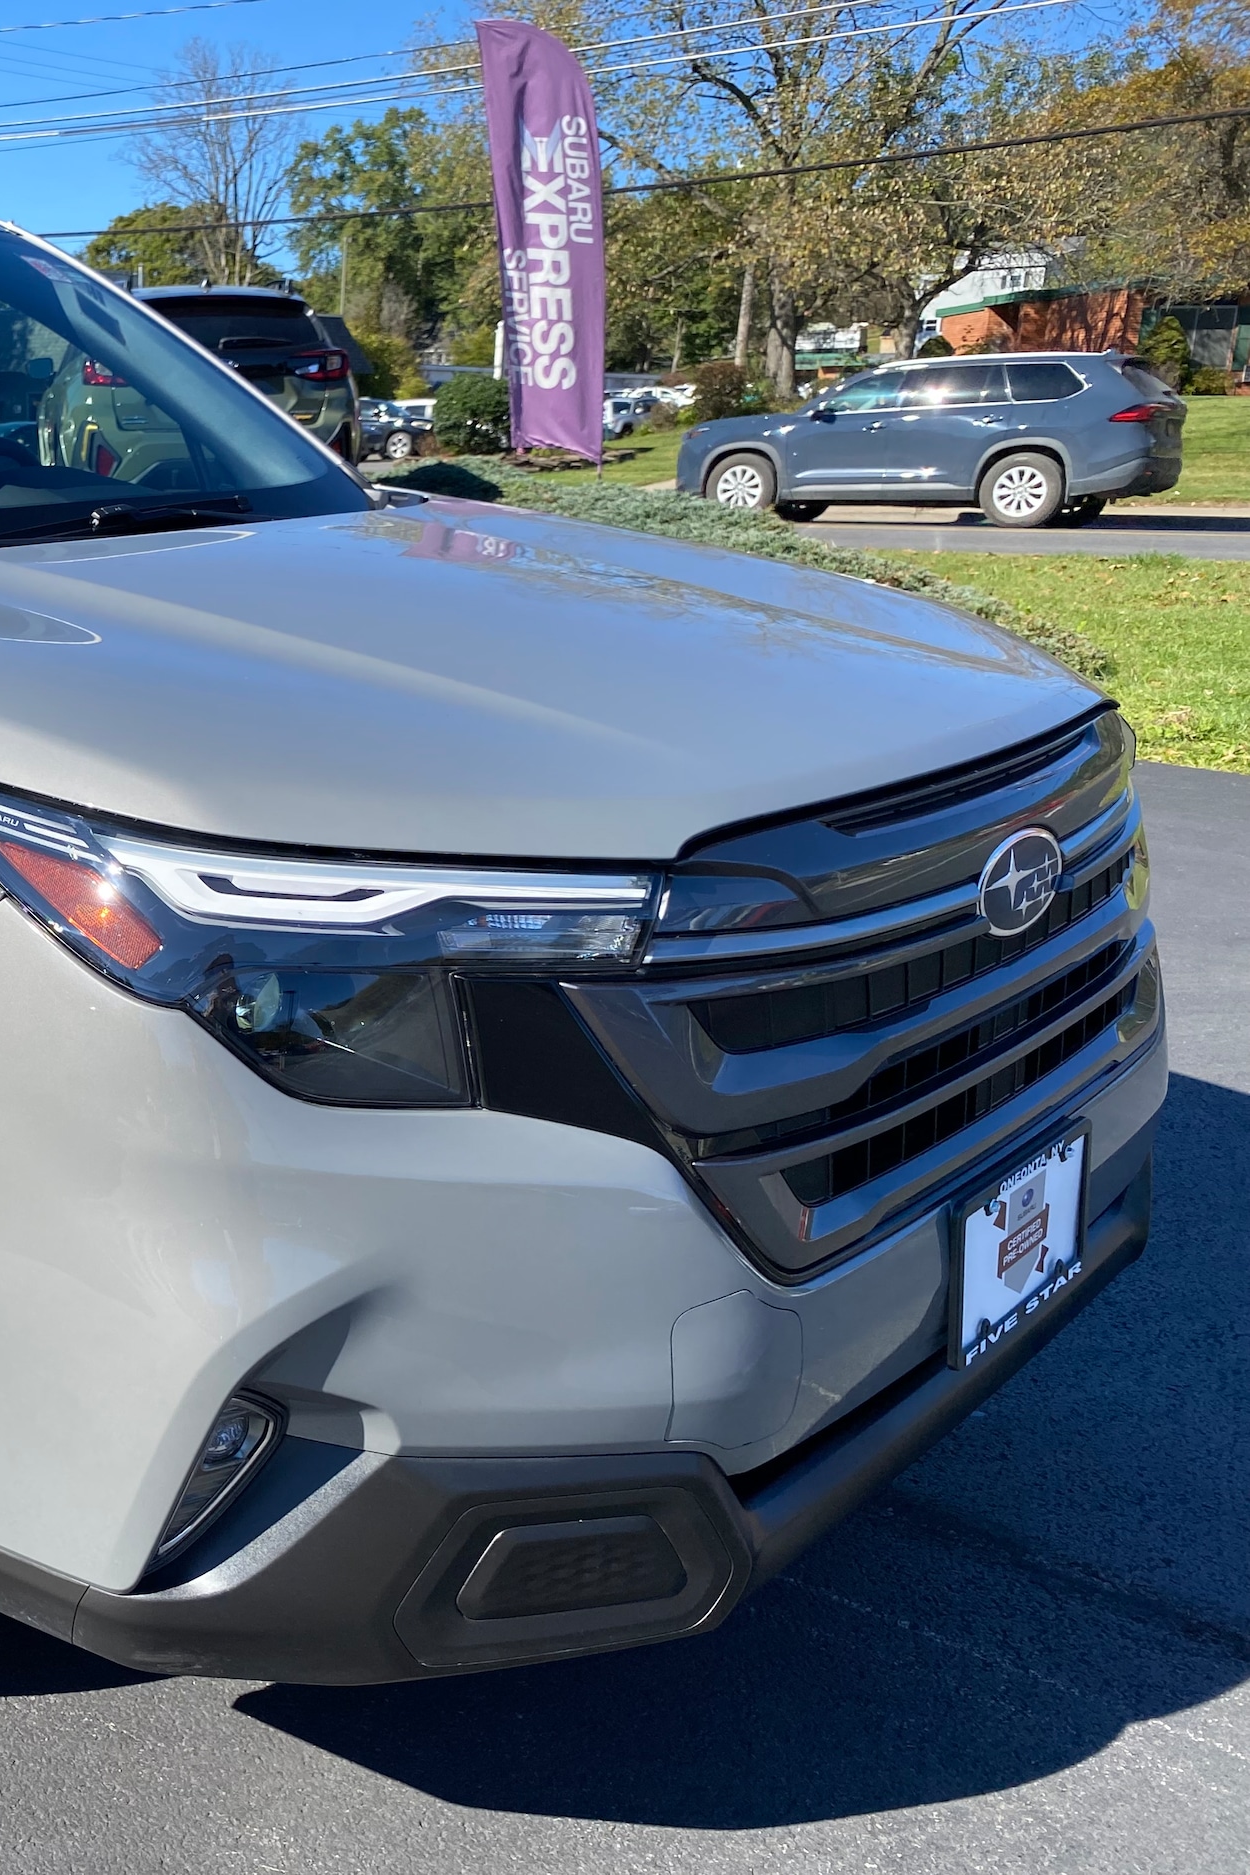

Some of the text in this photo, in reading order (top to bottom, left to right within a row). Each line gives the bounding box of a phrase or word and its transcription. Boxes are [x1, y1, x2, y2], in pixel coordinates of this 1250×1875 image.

[561, 114, 594, 244] SUBARU
[520, 120, 577, 390] EXPRESS
[503, 247, 534, 387] SERVICE
[1003, 1228, 1043, 1266] PRE-OWNED
[1007, 1218, 1041, 1251] CERTIFIED
[965, 1260, 1082, 1367] FIVE STAR
